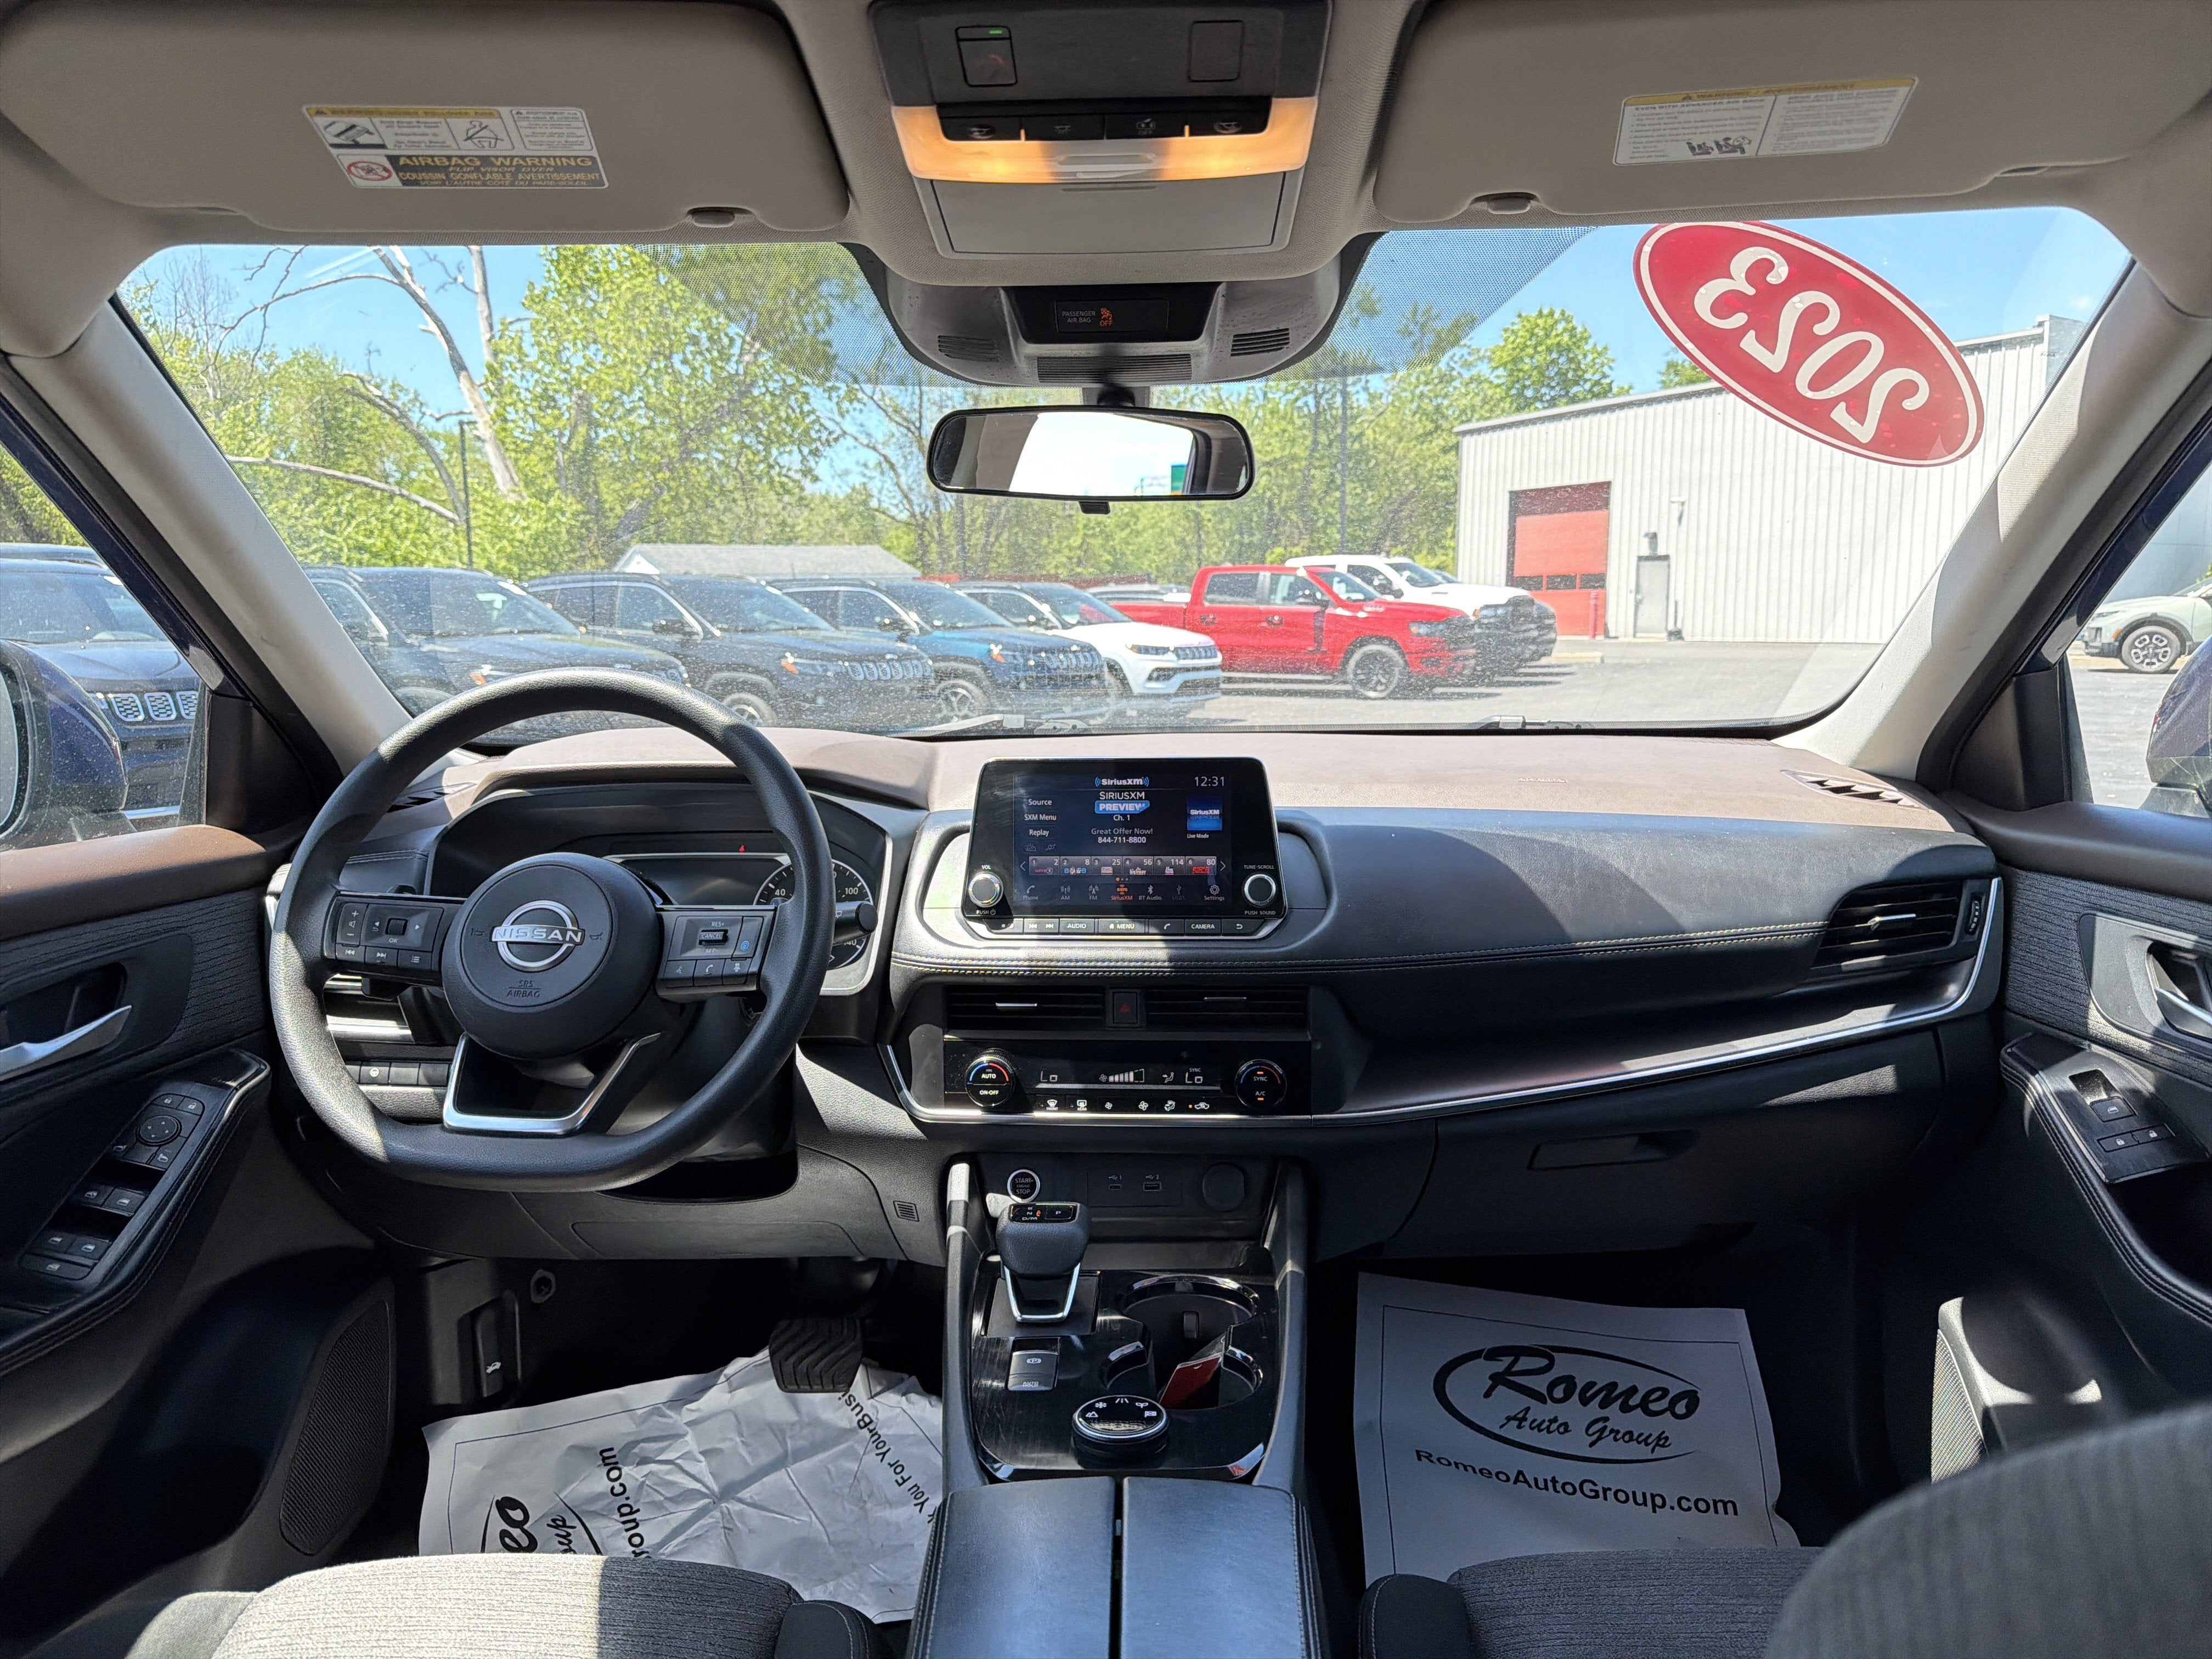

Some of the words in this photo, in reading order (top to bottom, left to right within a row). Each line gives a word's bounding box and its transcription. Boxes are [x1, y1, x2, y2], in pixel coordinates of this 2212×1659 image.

[399, 156, 481, 166] AIRBAG
[491, 156, 592, 166] WARNING
[1194, 776, 1225, 787] 12:31
[1099, 791, 1145, 800] SIRIUSXM
[1029, 829, 1049, 837] Replay
[494, 928, 582, 943] NISSAN
[507, 990, 540, 998] AIRBAG
[1483, 1344, 1700, 1421] Romeo
[1499, 1406, 1571, 1434] Auto
[1584, 1415, 1671, 1454] Group
[887, 1459, 912, 1487] For
[1414, 1449, 1739, 1516] RomeoAutoGroup.com
[907, 1483, 930, 1514] You
